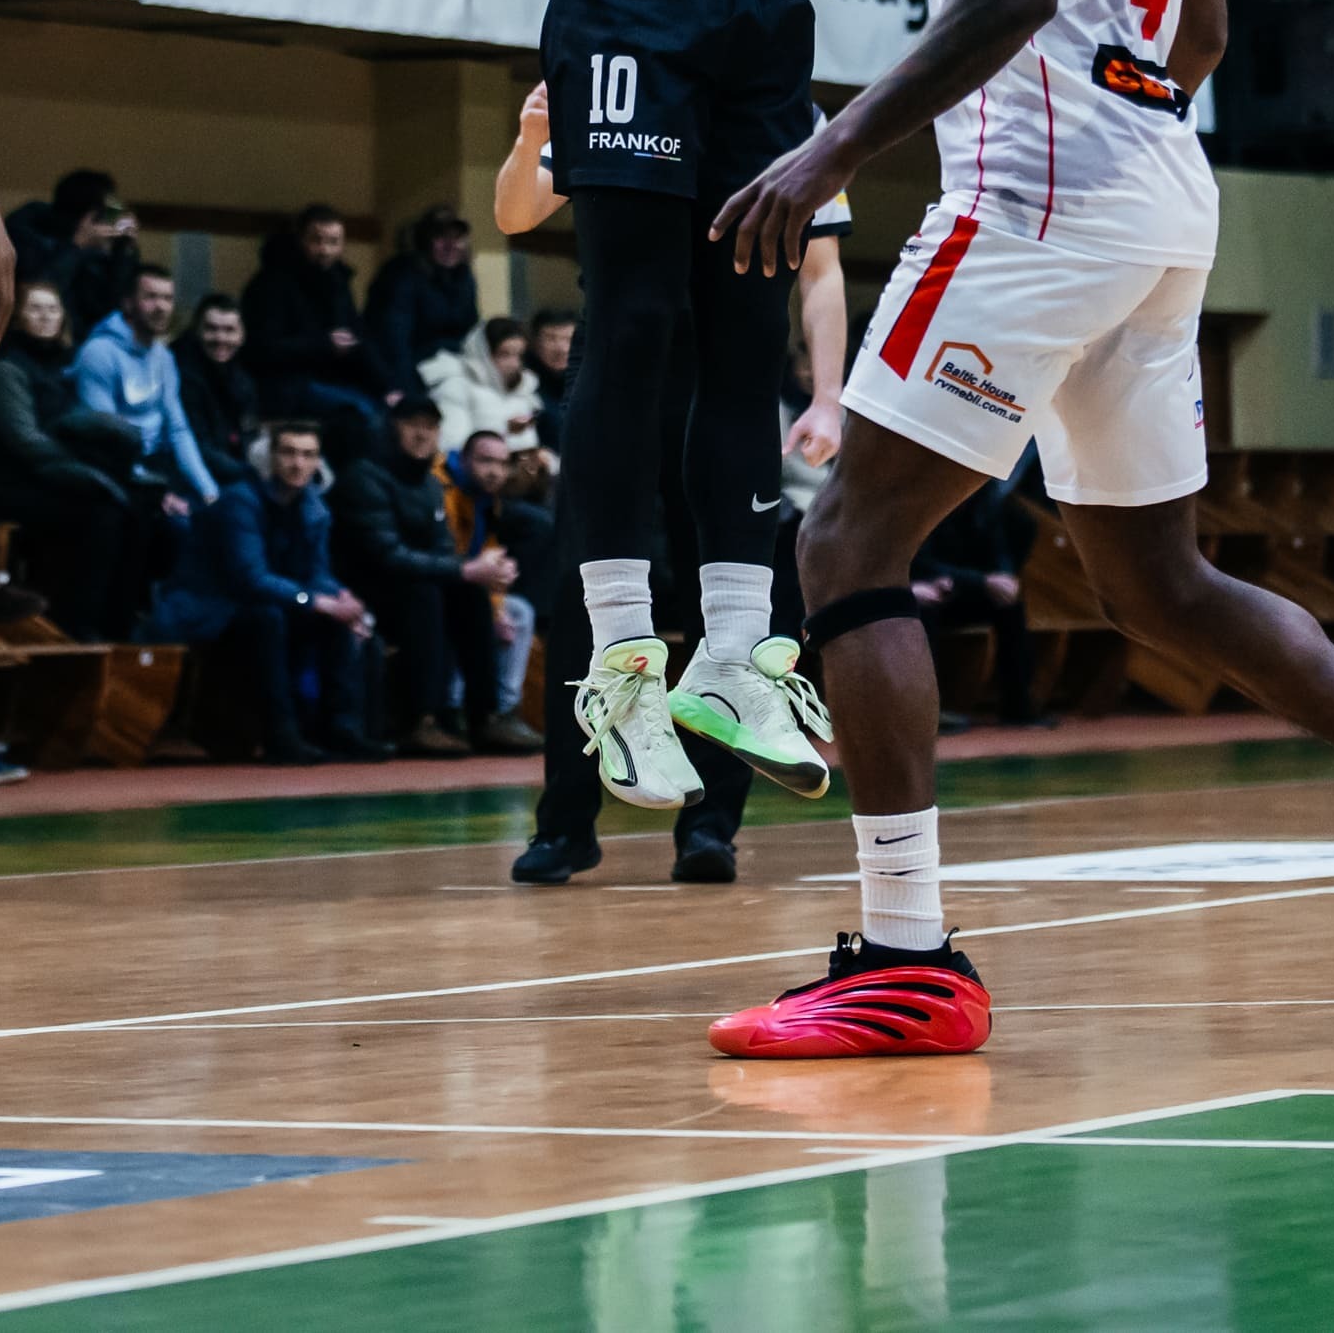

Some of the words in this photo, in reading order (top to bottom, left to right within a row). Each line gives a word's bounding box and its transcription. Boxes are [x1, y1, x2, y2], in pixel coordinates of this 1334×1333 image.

[589, 54, 637, 124] 10
[589, 132, 682, 155] FRANKOF
[934, 378, 1022, 424] rvmebli.com.ua
[942, 362, 978, 385] Baltic
[979, 379, 1016, 403] House
